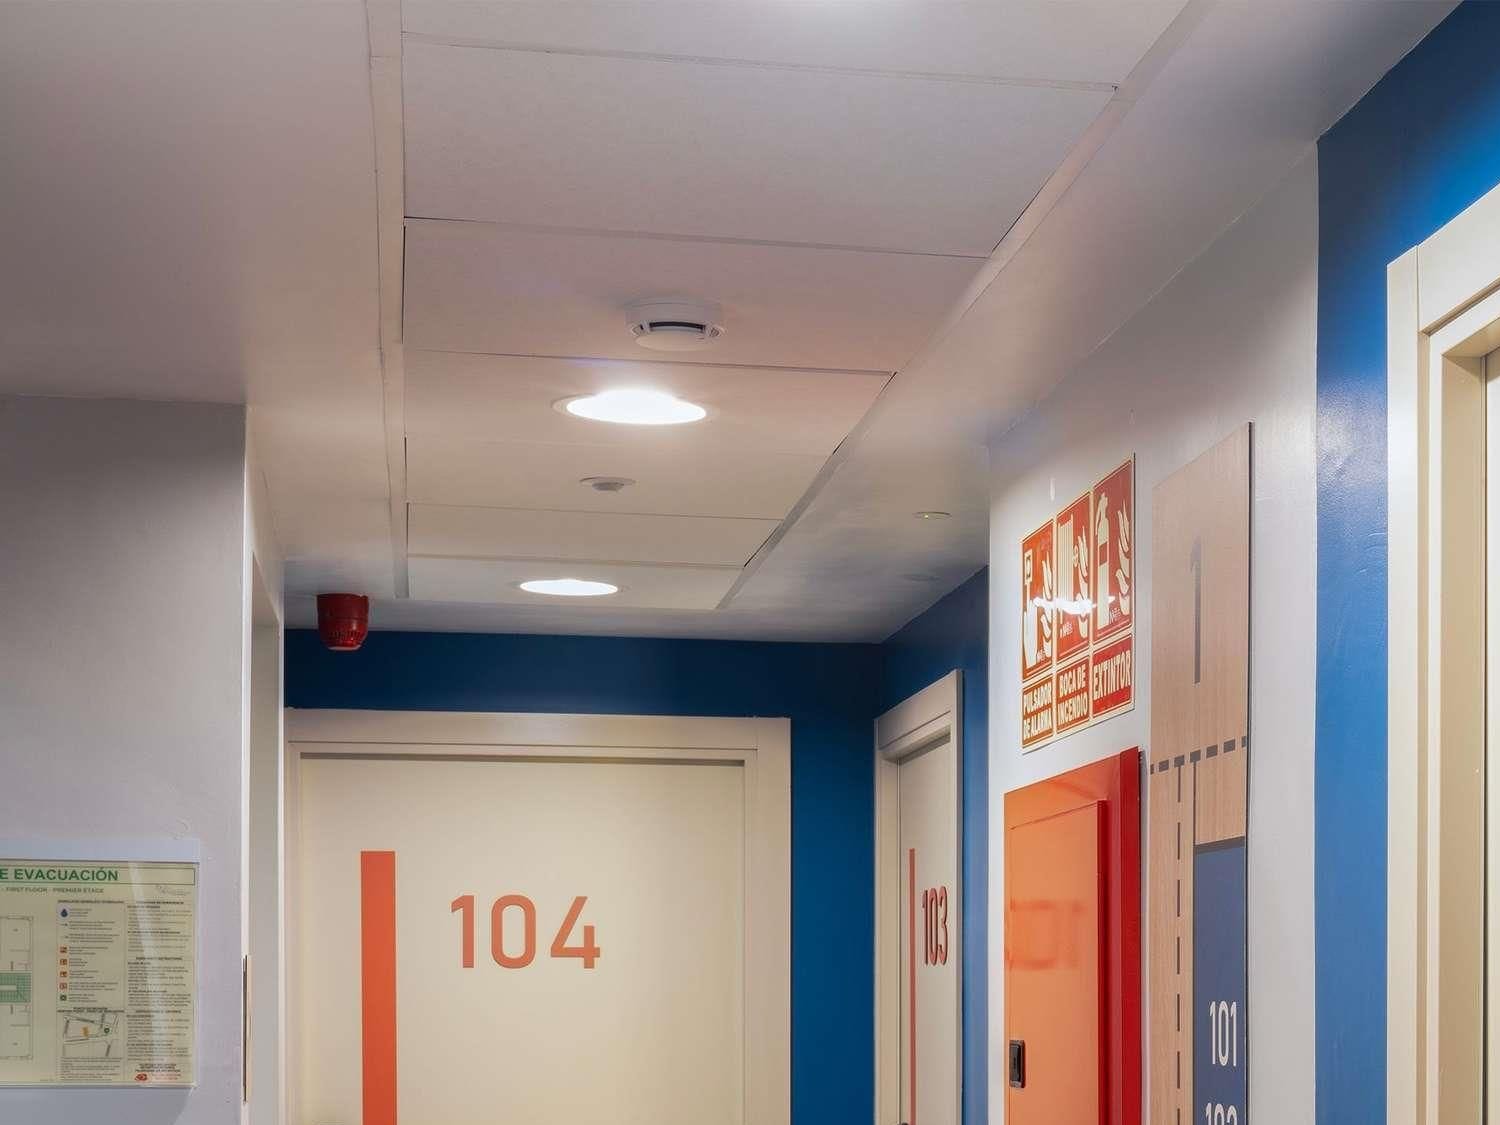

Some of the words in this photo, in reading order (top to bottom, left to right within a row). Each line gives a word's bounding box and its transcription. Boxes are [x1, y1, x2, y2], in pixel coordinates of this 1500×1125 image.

[1060, 668, 1078, 698] BOCA
[1078, 664, 1086, 689] DE
[1093, 650, 1131, 701] EXTINTOR
[1057, 691, 1088, 726] INCENDIO
[14, 866, 118, 881] EVACUACIÓN
[451, 894, 601, 969] 104
[921, 885, 948, 966] 103
[1209, 1000, 1238, 1067] 101
